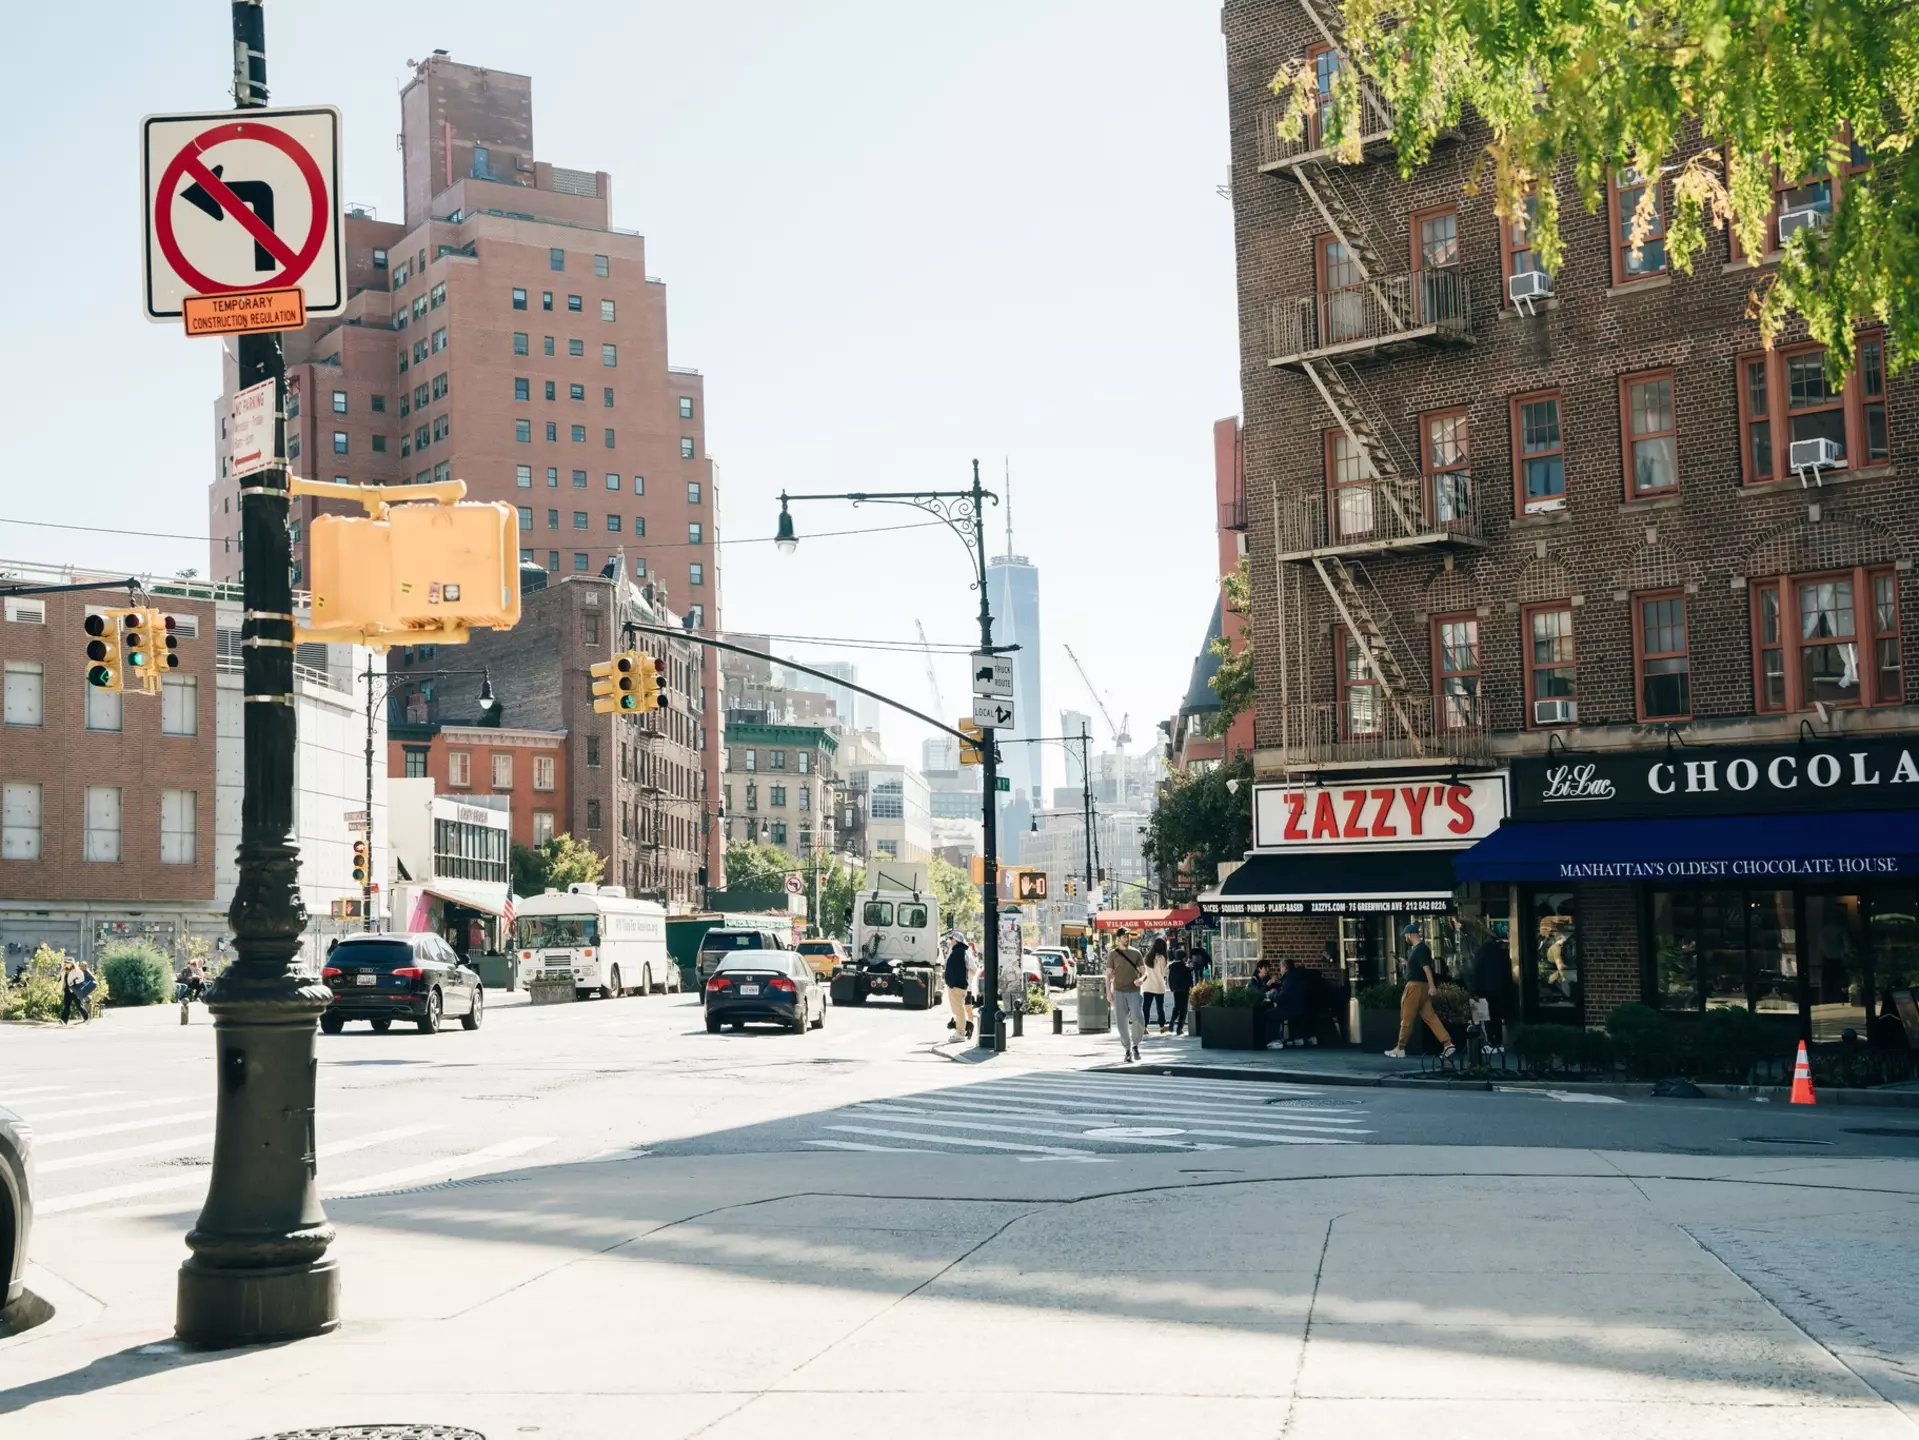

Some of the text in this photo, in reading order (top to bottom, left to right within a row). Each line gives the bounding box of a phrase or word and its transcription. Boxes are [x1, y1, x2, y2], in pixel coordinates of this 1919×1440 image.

[212, 297, 273, 312] TEMPORARY
[193, 310, 296, 329] CONSTRUCTION REGULATION
[994, 665, 1011, 674] TRUCK
[994, 678, 1011, 688] ROUTE
[975, 707, 995, 718] LOCAL
[1543, 750, 1919, 802] Li-Lac CHOCOLA
[1283, 785, 1475, 840] ZAZZY'S
[1560, 857, 1898, 877] MANHATTAN'S OLDEST CHOCOLATE HOUSE
[1221, 904, 1244, 912] SQUARES
[1246, 904, 1266, 912] PARMS
[1268, 903, 1304, 912] PLANT-BASED
[1311, 902, 1346, 912] ZAZZYS.COM
[1348, 902, 1356, 911] 75
[1357, 902, 1390, 911] GREENWICH
[1391, 902, 1403, 911] AVE
[1405, 901, 1417, 911] 212
[1418, 901, 1430, 910] 542
